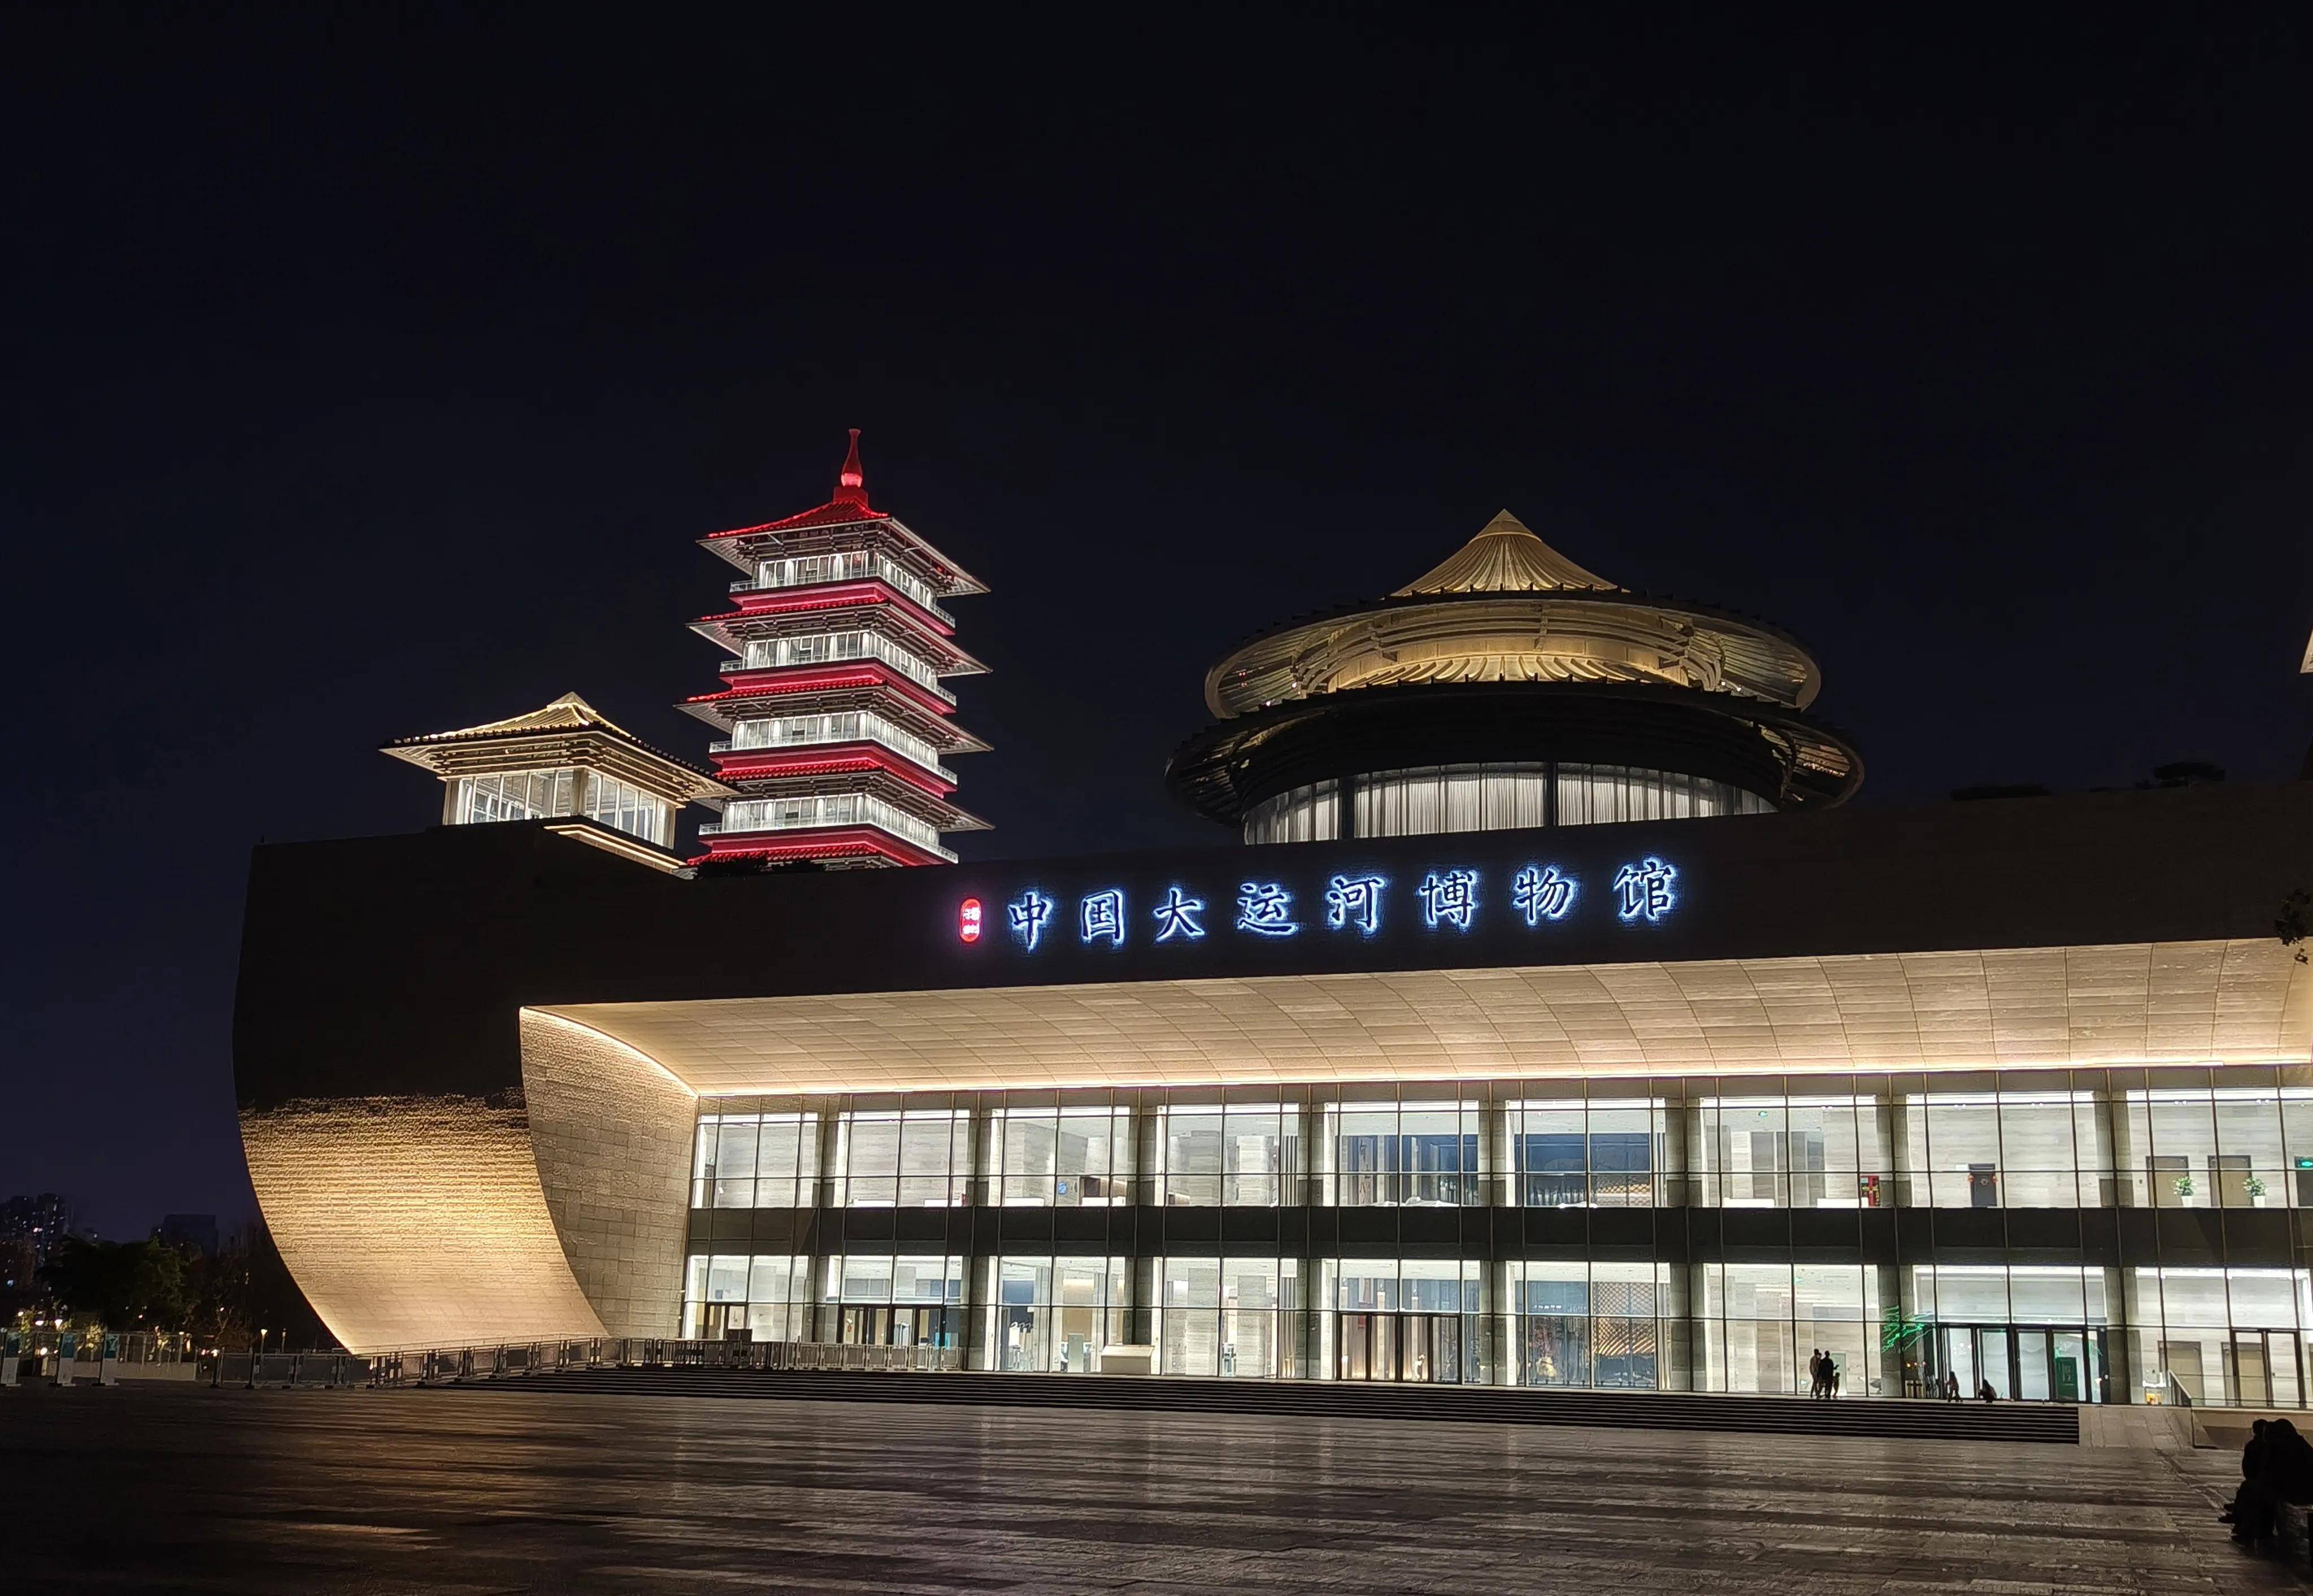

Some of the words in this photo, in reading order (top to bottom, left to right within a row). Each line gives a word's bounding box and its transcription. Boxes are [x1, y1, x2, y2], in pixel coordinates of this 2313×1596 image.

[1009, 859, 1674, 952] 中国大运河博物馆
